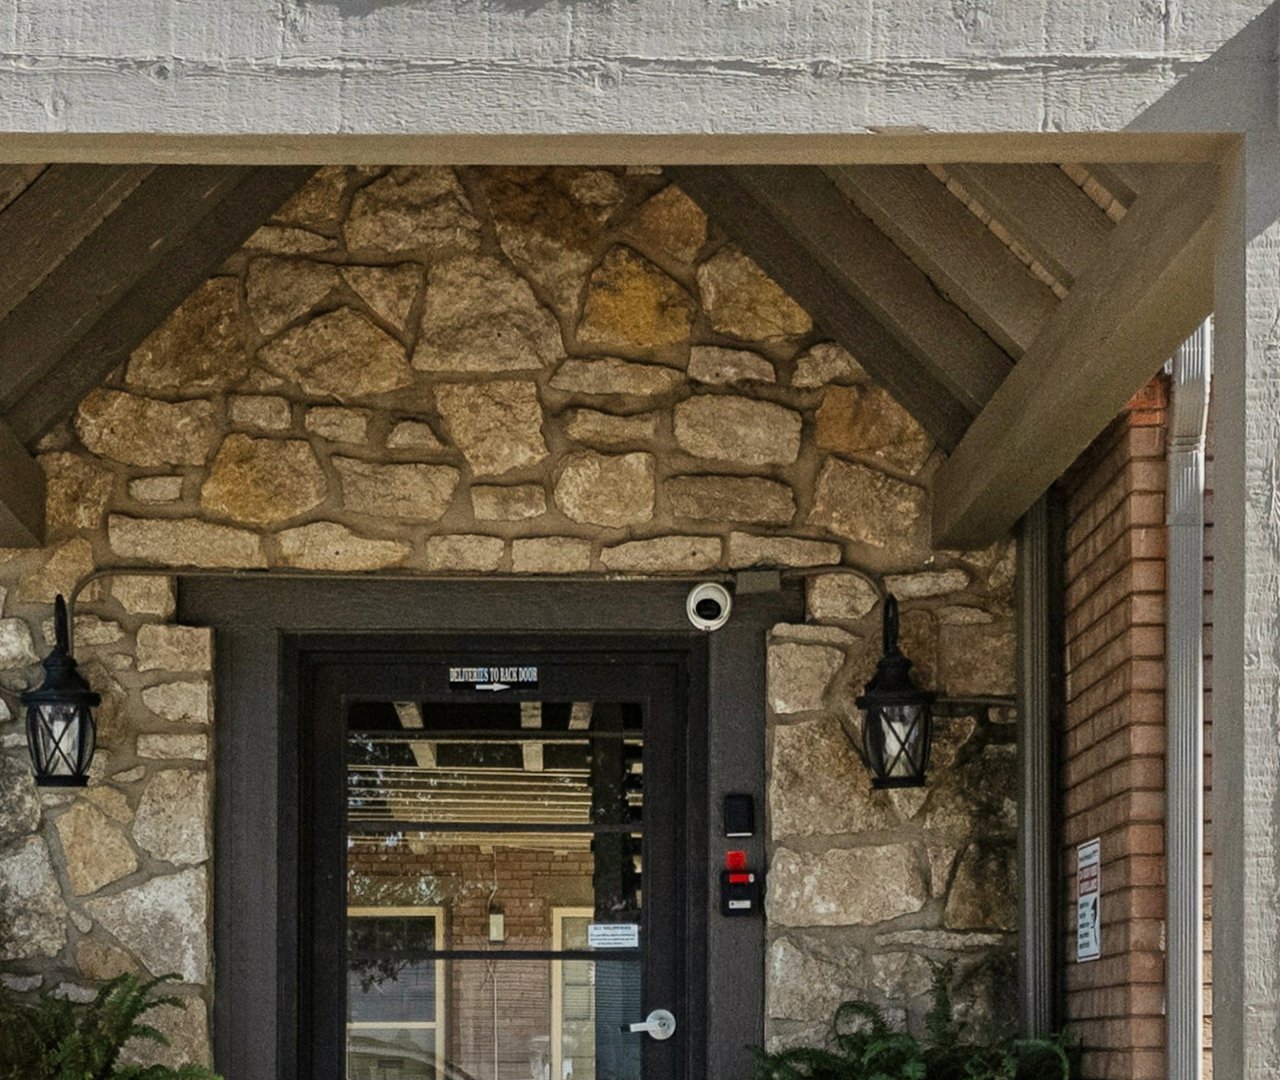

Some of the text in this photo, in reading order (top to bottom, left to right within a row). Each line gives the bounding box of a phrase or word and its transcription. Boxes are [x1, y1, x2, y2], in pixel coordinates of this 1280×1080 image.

[449, 667, 538, 682] DELIVERIES TO BACK DOOR
